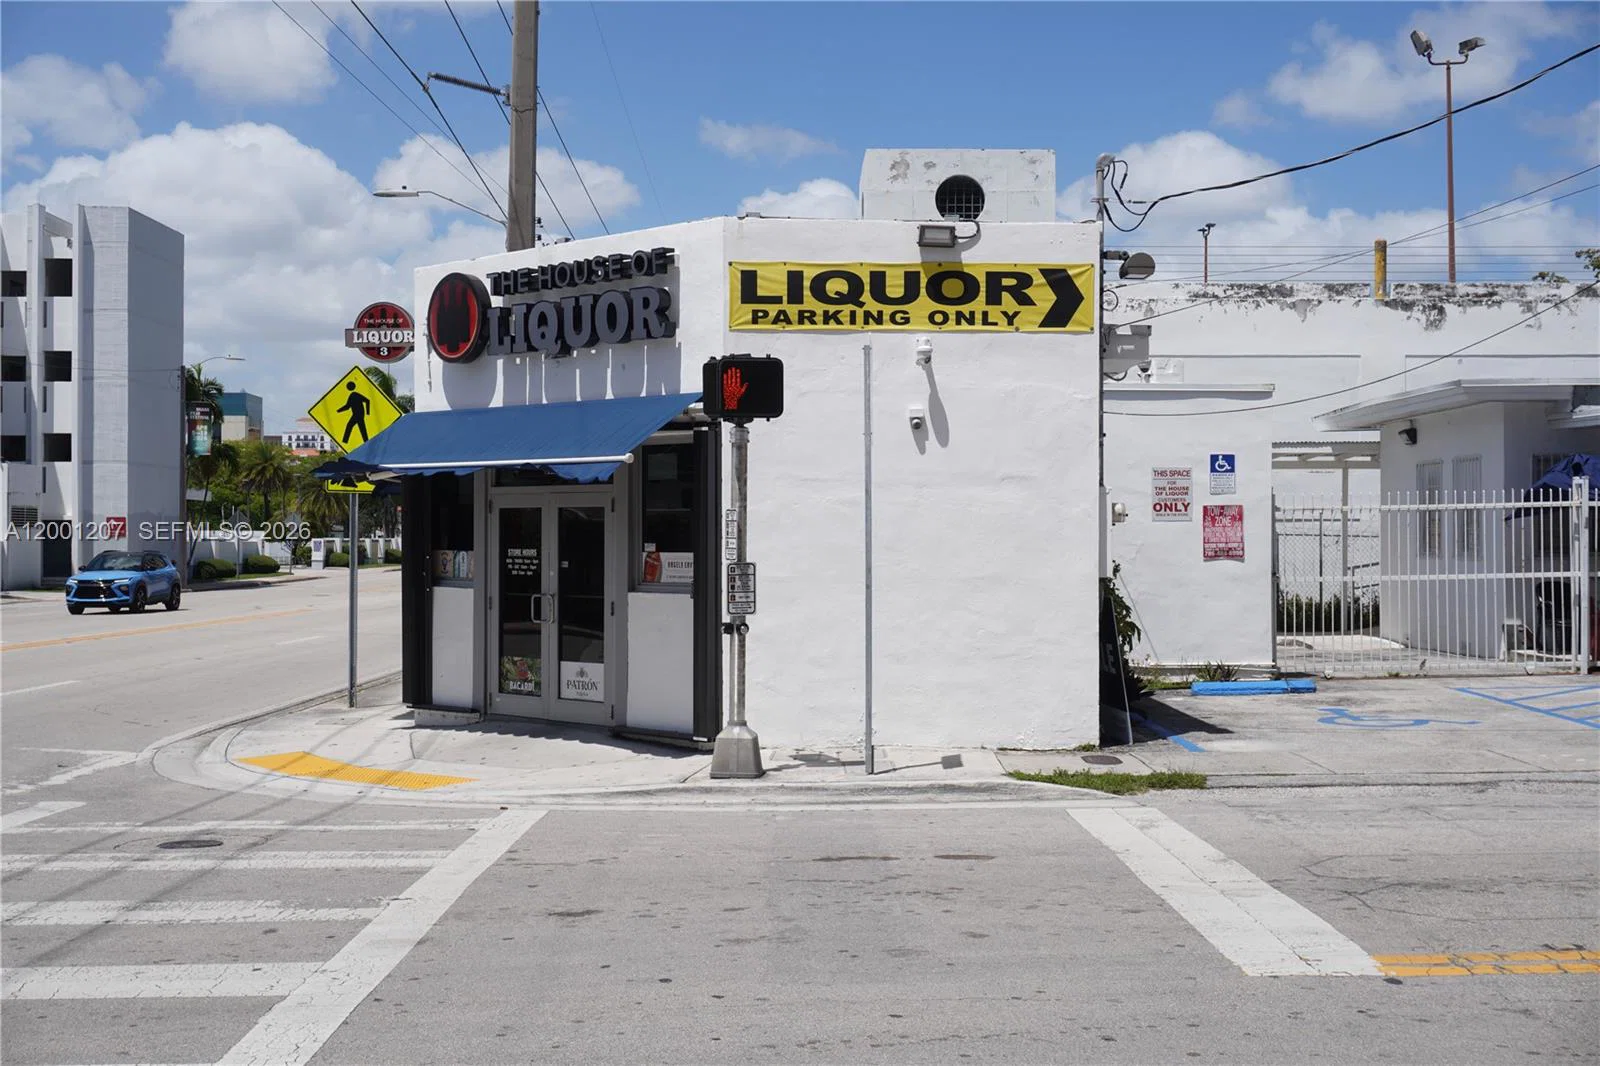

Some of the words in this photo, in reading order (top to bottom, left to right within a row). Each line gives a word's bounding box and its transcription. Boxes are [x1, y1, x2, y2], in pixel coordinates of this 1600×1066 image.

[486, 267, 532, 296] THE
[538, 254, 623, 290] HOUSE
[631, 248, 673, 276] OF
[740, 270, 1037, 309] LIQUOR
[487, 286, 674, 358] LIQUOR
[751, 309, 911, 326] PARKING
[927, 309, 1022, 327] ONLY
[353, 330, 414, 344] LIQUOR
[380, 347, 388, 356] 3
[1152, 502, 1191, 512] ONLY
[1215, 516, 1232, 527] ZONE
